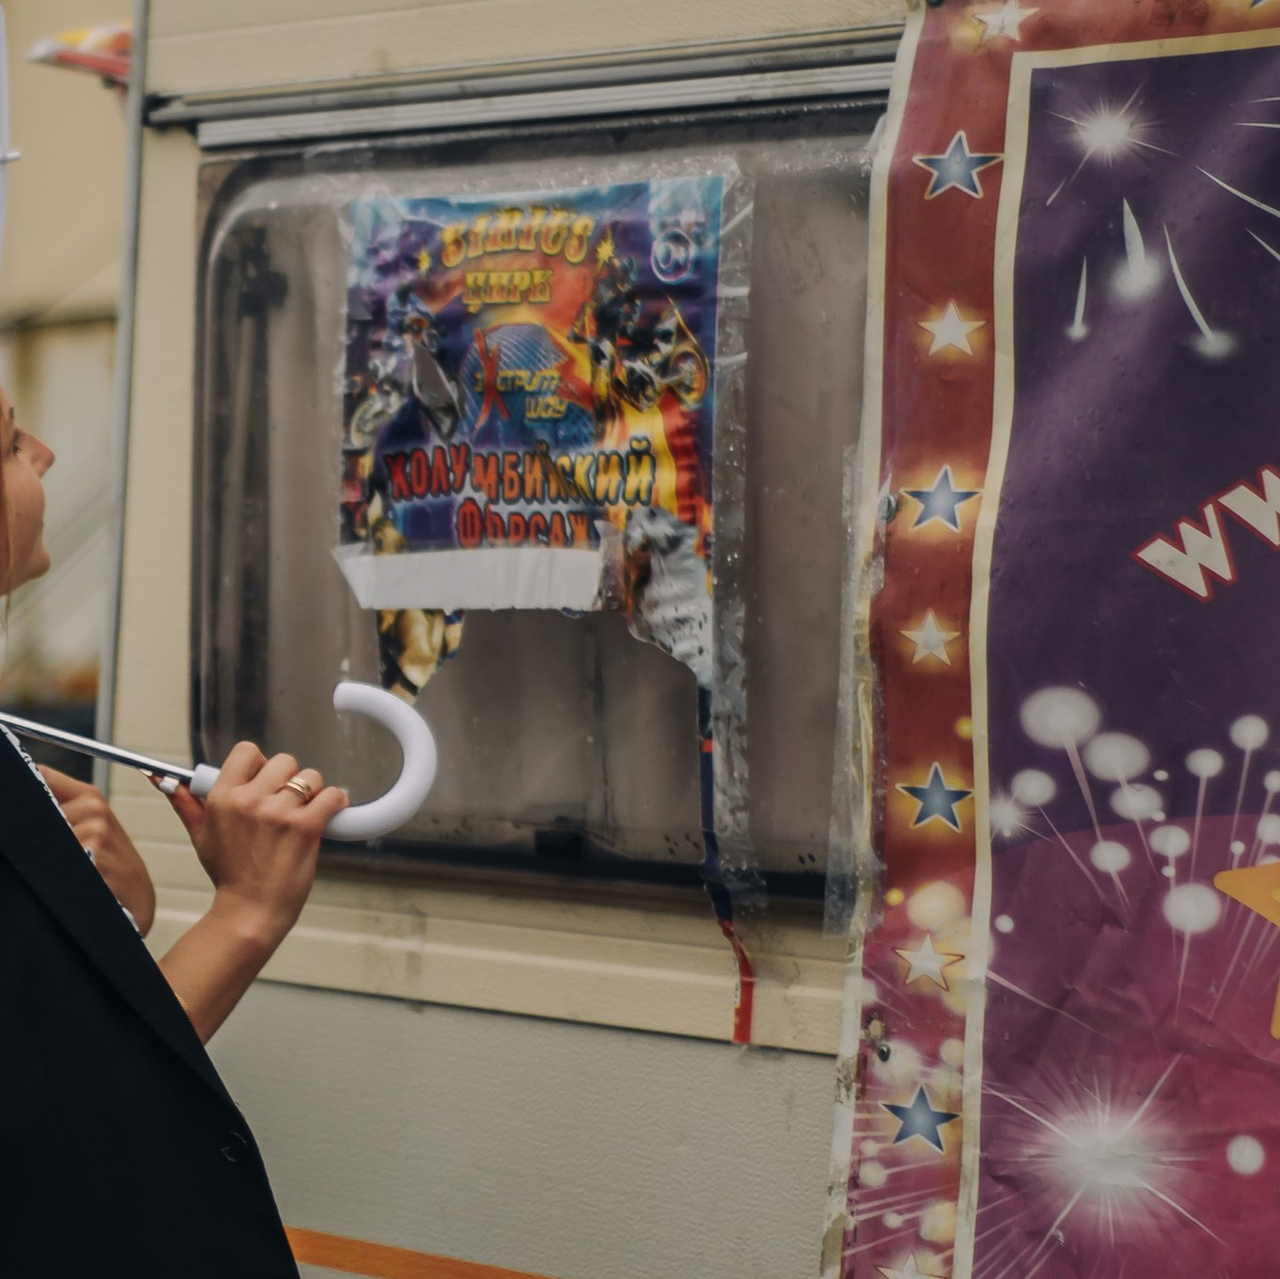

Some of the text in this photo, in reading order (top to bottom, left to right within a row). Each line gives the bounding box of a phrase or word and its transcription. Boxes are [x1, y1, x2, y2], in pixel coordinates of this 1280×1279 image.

[440, 206, 595, 268] SIRIUS
[462, 268, 554, 314] ЦИРК
[384, 436, 656, 506] КОЛУМБИЙСКИЙ
